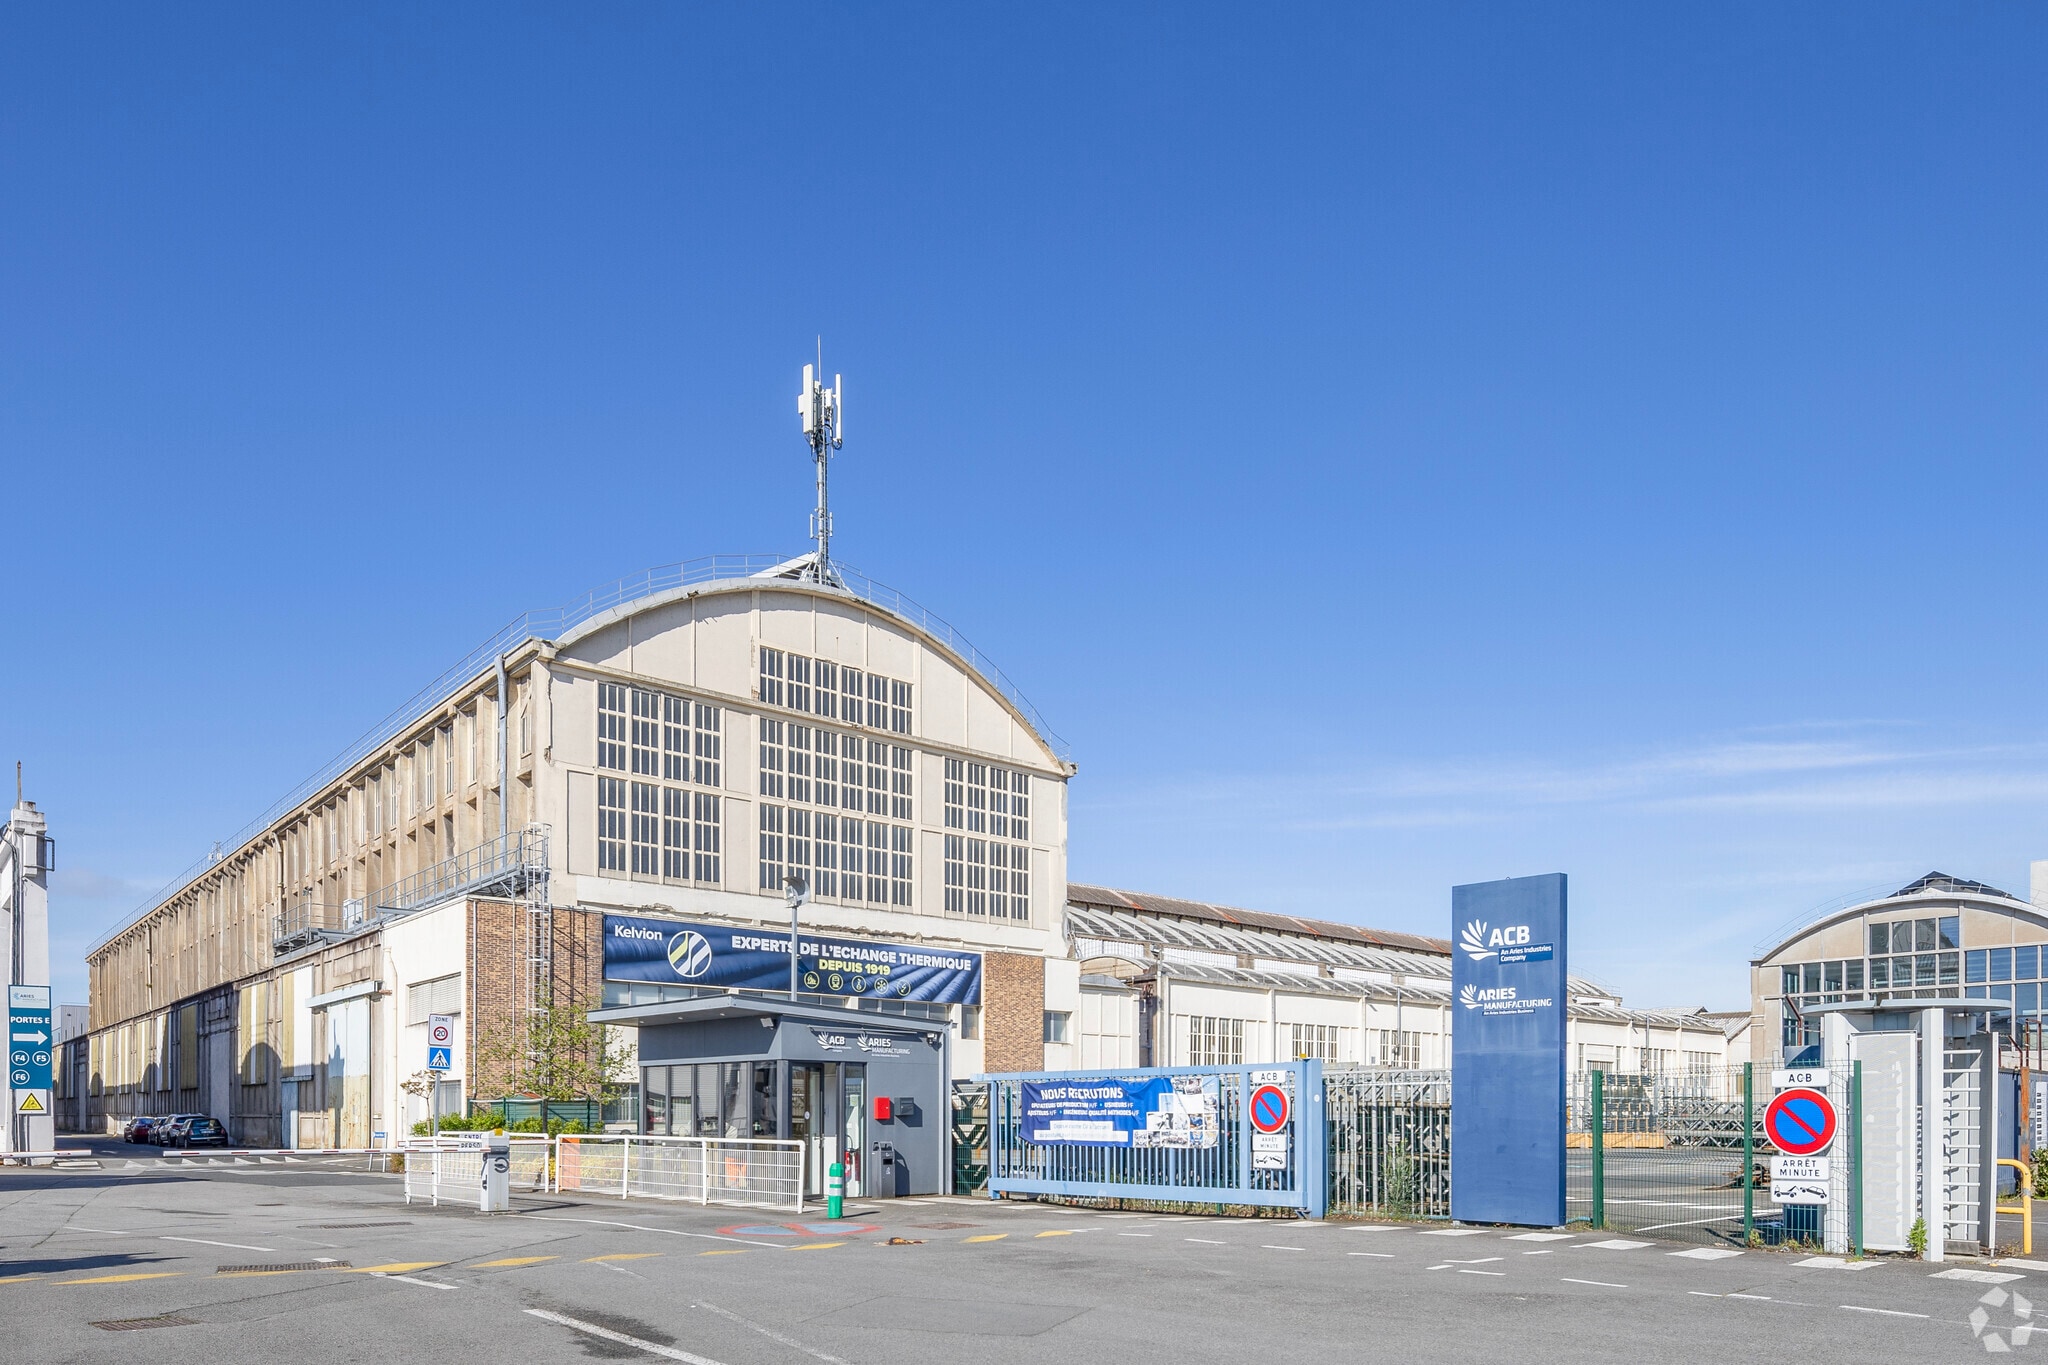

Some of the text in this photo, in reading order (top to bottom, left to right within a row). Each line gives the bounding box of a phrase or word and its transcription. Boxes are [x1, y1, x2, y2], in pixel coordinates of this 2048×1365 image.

[614, 925, 663, 941] Kelvion
[1488, 925, 1531, 947] ACB
[1509, 947, 1524, 955] Aries
[1523, 945, 1552, 954] Industries
[799, 942, 819, 956] DE
[898, 952, 972, 971] THERMIQUE
[1500, 954, 1527, 962] Company
[818, 959, 891, 976] DEPUIS 1919
[1477, 987, 1516, 1001] ARIES
[1483, 998, 1552, 1010] MANUFACTURING
[10, 1016, 43, 1024] PORTES
[829, 1035, 846, 1045] ACB
[868, 1037, 892, 1047] ARIES
[871, 1047, 911, 1055] MANUFACTURING
[15, 1054, 26, 1062] F4
[36, 1054, 47, 1062] F5
[15, 1073, 26, 1081] F6
[1260, 1072, 1278, 1081] ACB
[1788, 1073, 1813, 1083] ACB
[1040, 1087, 1067, 1100] NOUS
[1782, 1158, 1817, 1168] ARRÊT
[1779, 1168, 1820, 1177] MINUTE
